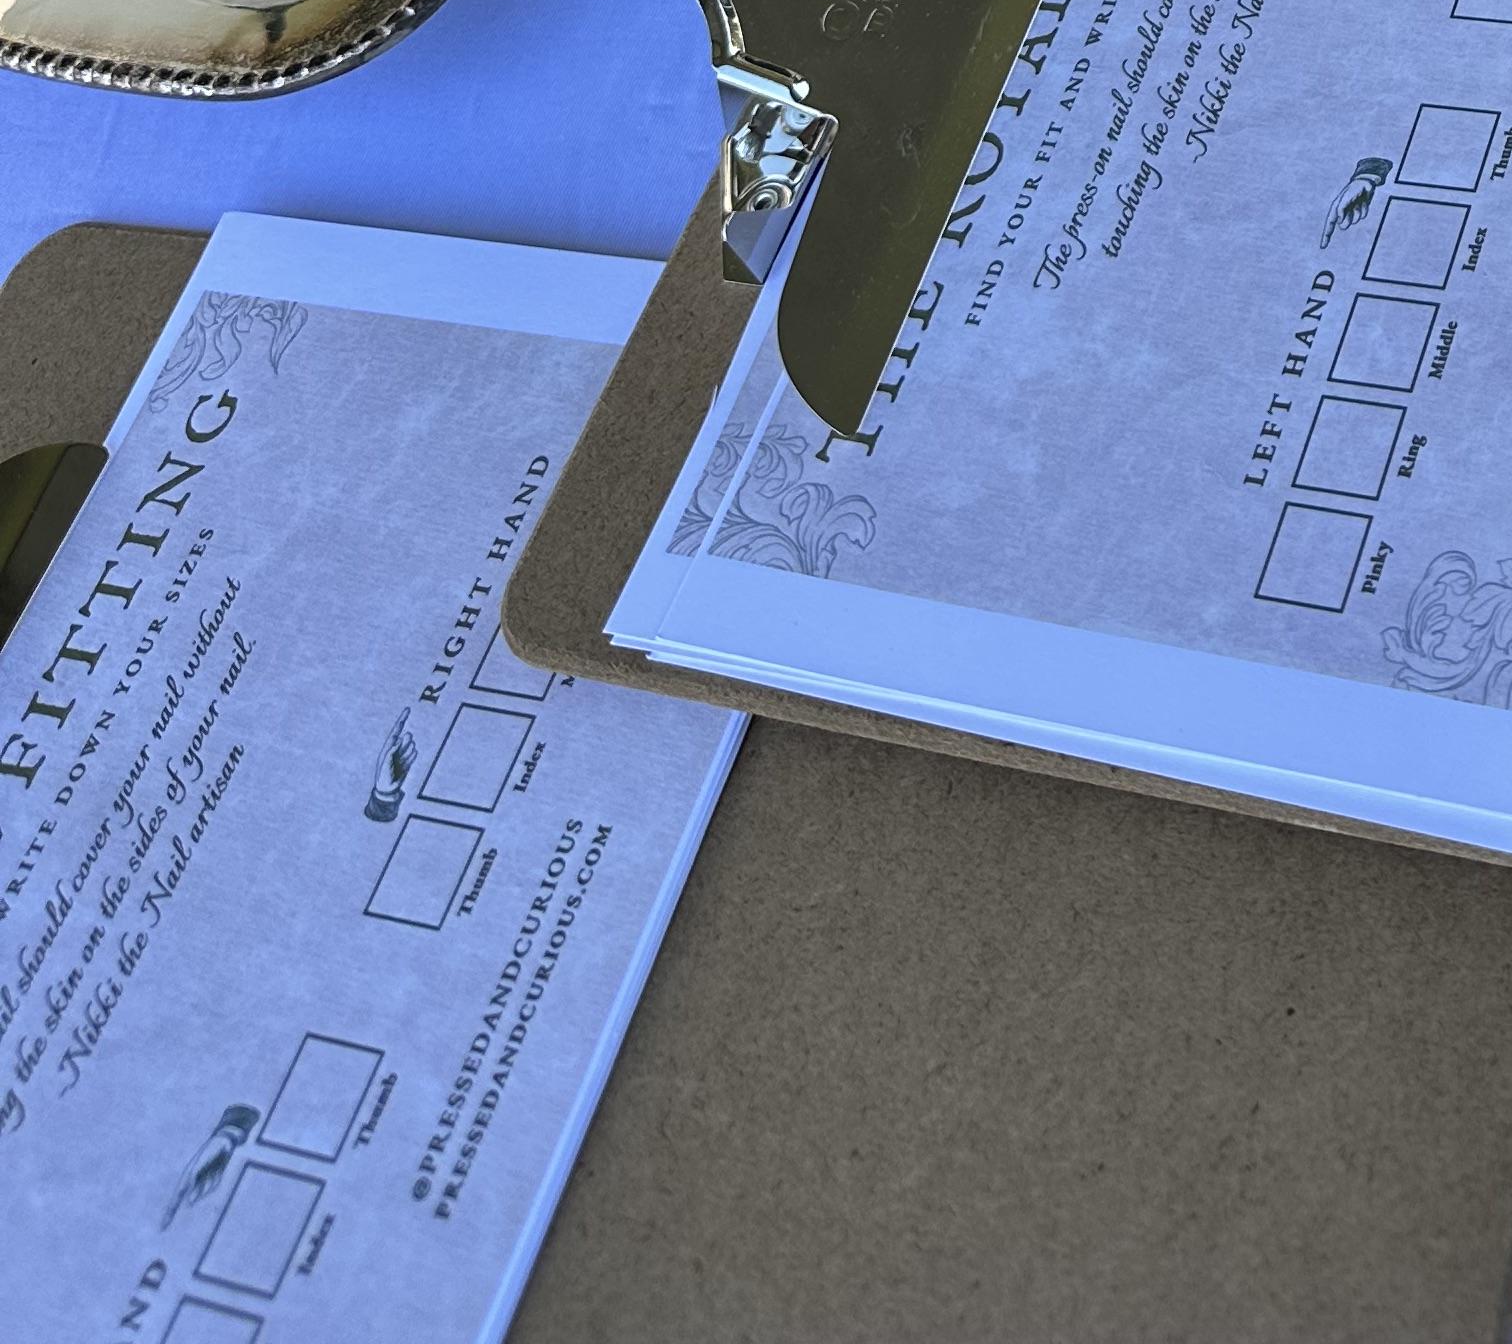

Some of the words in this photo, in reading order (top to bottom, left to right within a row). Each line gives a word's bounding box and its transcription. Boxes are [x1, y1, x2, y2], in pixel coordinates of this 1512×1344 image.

[1140, 122, 1168, 156] the
[1157, 71, 1189, 120] skin
[1184, 40, 1202, 68] on
[1189, 4, 1222, 36] the
[1218, 42, 1246, 75] the
[964, 260, 1004, 327] FIND
[995, 174, 1043, 249] YOUR
[1033, 121, 1064, 164] FIT
[1059, 58, 1091, 112] AND
[1032, 243, 1072, 290] The
[1062, 147, 1112, 261] press-on
[1106, 88, 1133, 143] nail
[1122, 9, 1164, 95] should
[1101, 160, 1163, 258] touching
[1243, 393, 1292, 488] LEFT
[1281, 270, 1335, 378] HAND
[1359, 540, 1394, 595] Pinky
[1396, 434, 1427, 479] Ring
[1427, 321, 1458, 380] Middle
[1461, 227, 1488, 272] Index
[0, 388, 239, 790] FITTING
[53, 709, 115, 806] DOWN
[112, 616, 168, 696] YOUR
[162, 528, 214, 603] SIZES
[418, 576, 492, 706] RIGHT
[485, 455, 549, 563] HAND
[14, 1035, 47, 1085] the
[44, 968, 84, 1035] skin
[81, 925, 105, 964] on
[99, 875, 131, 921] the
[127, 805, 168, 874] sides
[166, 757, 186, 804] of
[180, 699, 225, 782] your
[219, 632, 256, 696] nail.
[16, 878, 73, 996] should
[67, 817, 111, 894] cover
[112, 742, 151, 830] your
[151, 674, 189, 740] nail
[175, 575, 241, 680] without
[117, 931, 149, 977] the
[137, 834, 192, 929] Nail
[189, 745, 244, 844] artisan
[455, 848, 498, 918] Thumb
[512, 741, 547, 793] Index
[352, 1072, 398, 1150] Thumb
[411, 819, 583, 1202] @PRESSEDANDCURIOUS
[432, 824, 613, 1221] PRESSEDANDCURIOUS.COM
